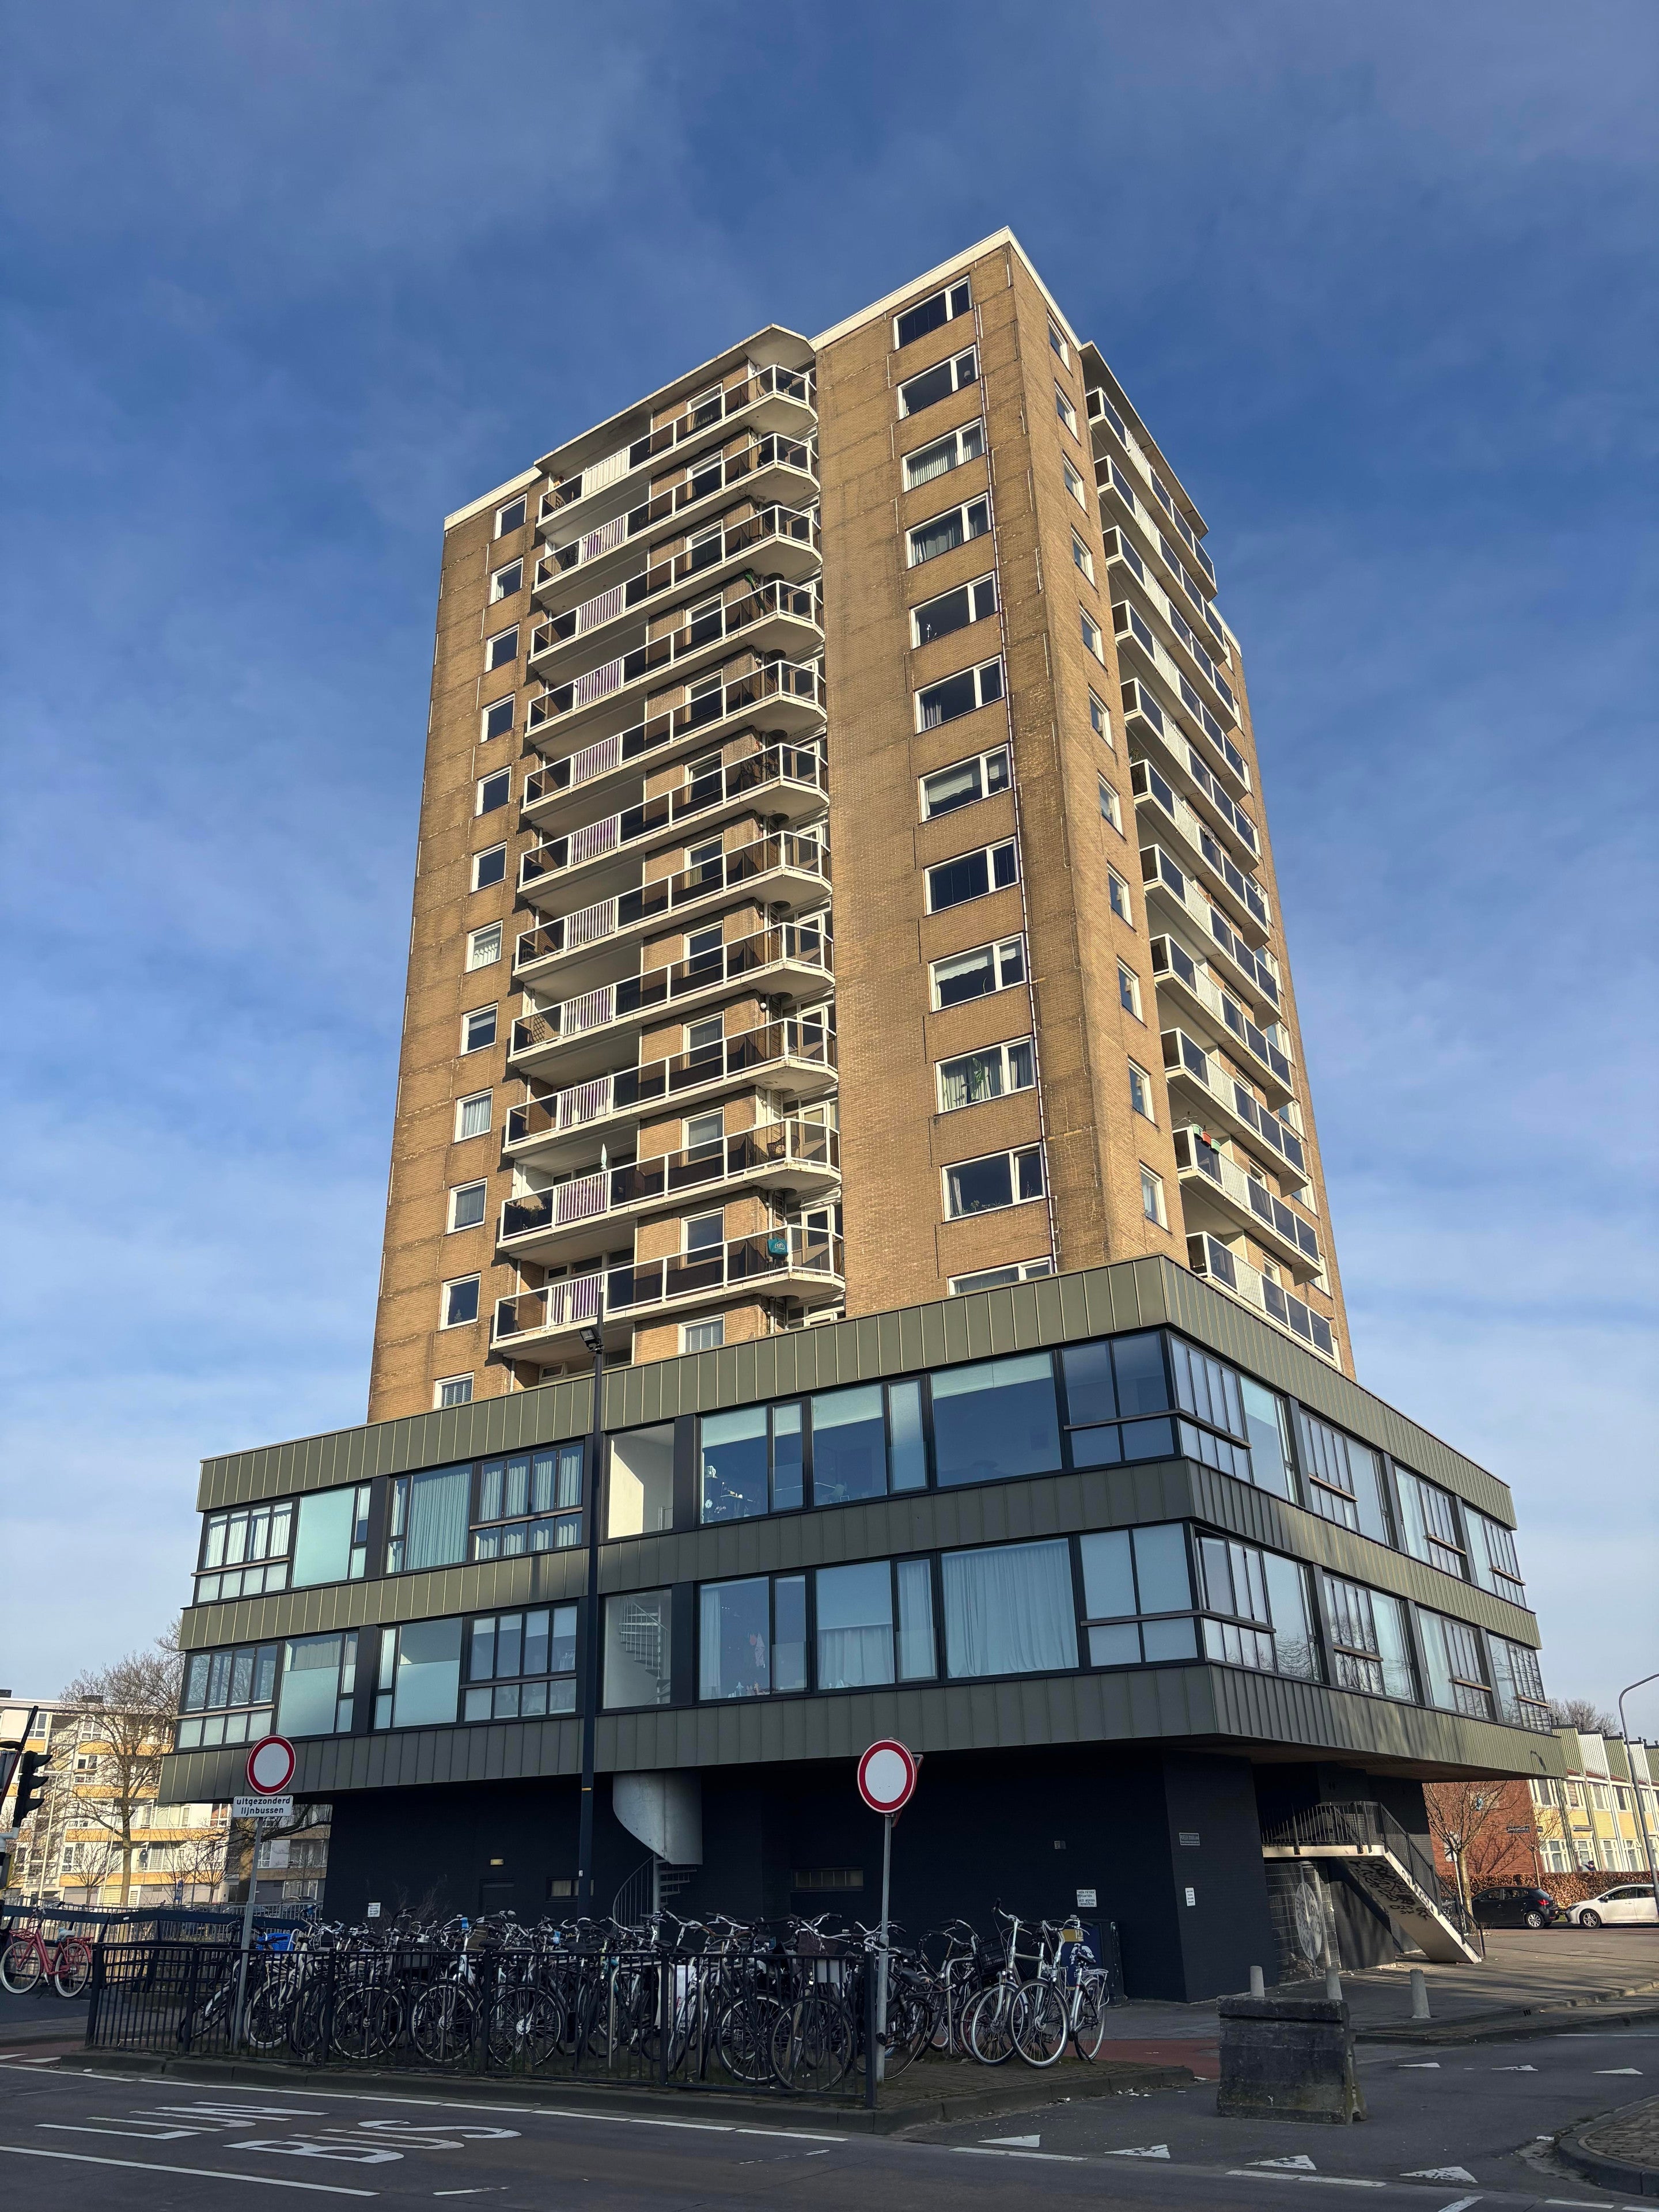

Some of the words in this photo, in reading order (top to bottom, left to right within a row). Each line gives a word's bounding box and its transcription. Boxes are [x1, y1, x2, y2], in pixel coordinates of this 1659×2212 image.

[237, 1797, 290, 1806] uitgezonderd
[241, 1807, 284, 1816] lijnbussen
[34, 2101, 329, 2140] LIJN
[222, 2120, 522, 2164] BUS
